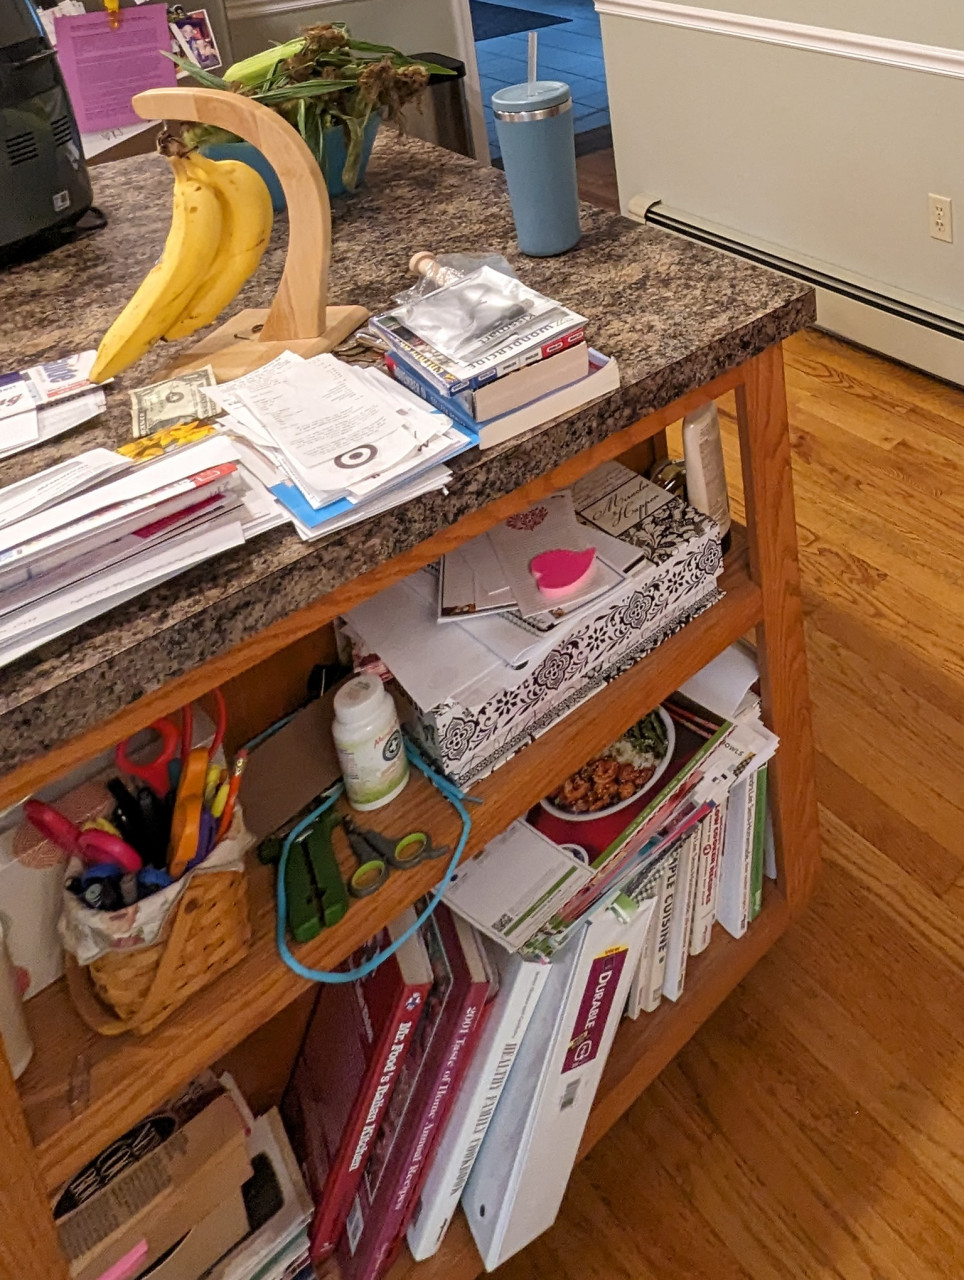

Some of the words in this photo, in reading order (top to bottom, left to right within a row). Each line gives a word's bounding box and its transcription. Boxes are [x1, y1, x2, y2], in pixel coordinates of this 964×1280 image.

[723, 741, 744, 756] OWLS
[658, 894, 674, 953] CUISINE
[460, 1006, 477, 1034] 2001
[584, 970, 613, 1031] DURABLE
[394, 1020, 412, 1043] Mr.
[380, 1043, 405, 1083] Food's
[448, 1037, 467, 1067] Taste
[489, 1043, 518, 1090] HEALTHY
[442, 1070, 452, 1083] of
[365, 1083, 390, 1123] Italian
[428, 1083, 448, 1119] Home
[473, 1095, 497, 1134] FAMILY
[349, 1124, 376, 1171] Kitchen
[412, 1122, 434, 1163] Annual
[394, 1163, 418, 1210] Recipes
[450, 1138, 482, 1196] COOKBOOK
